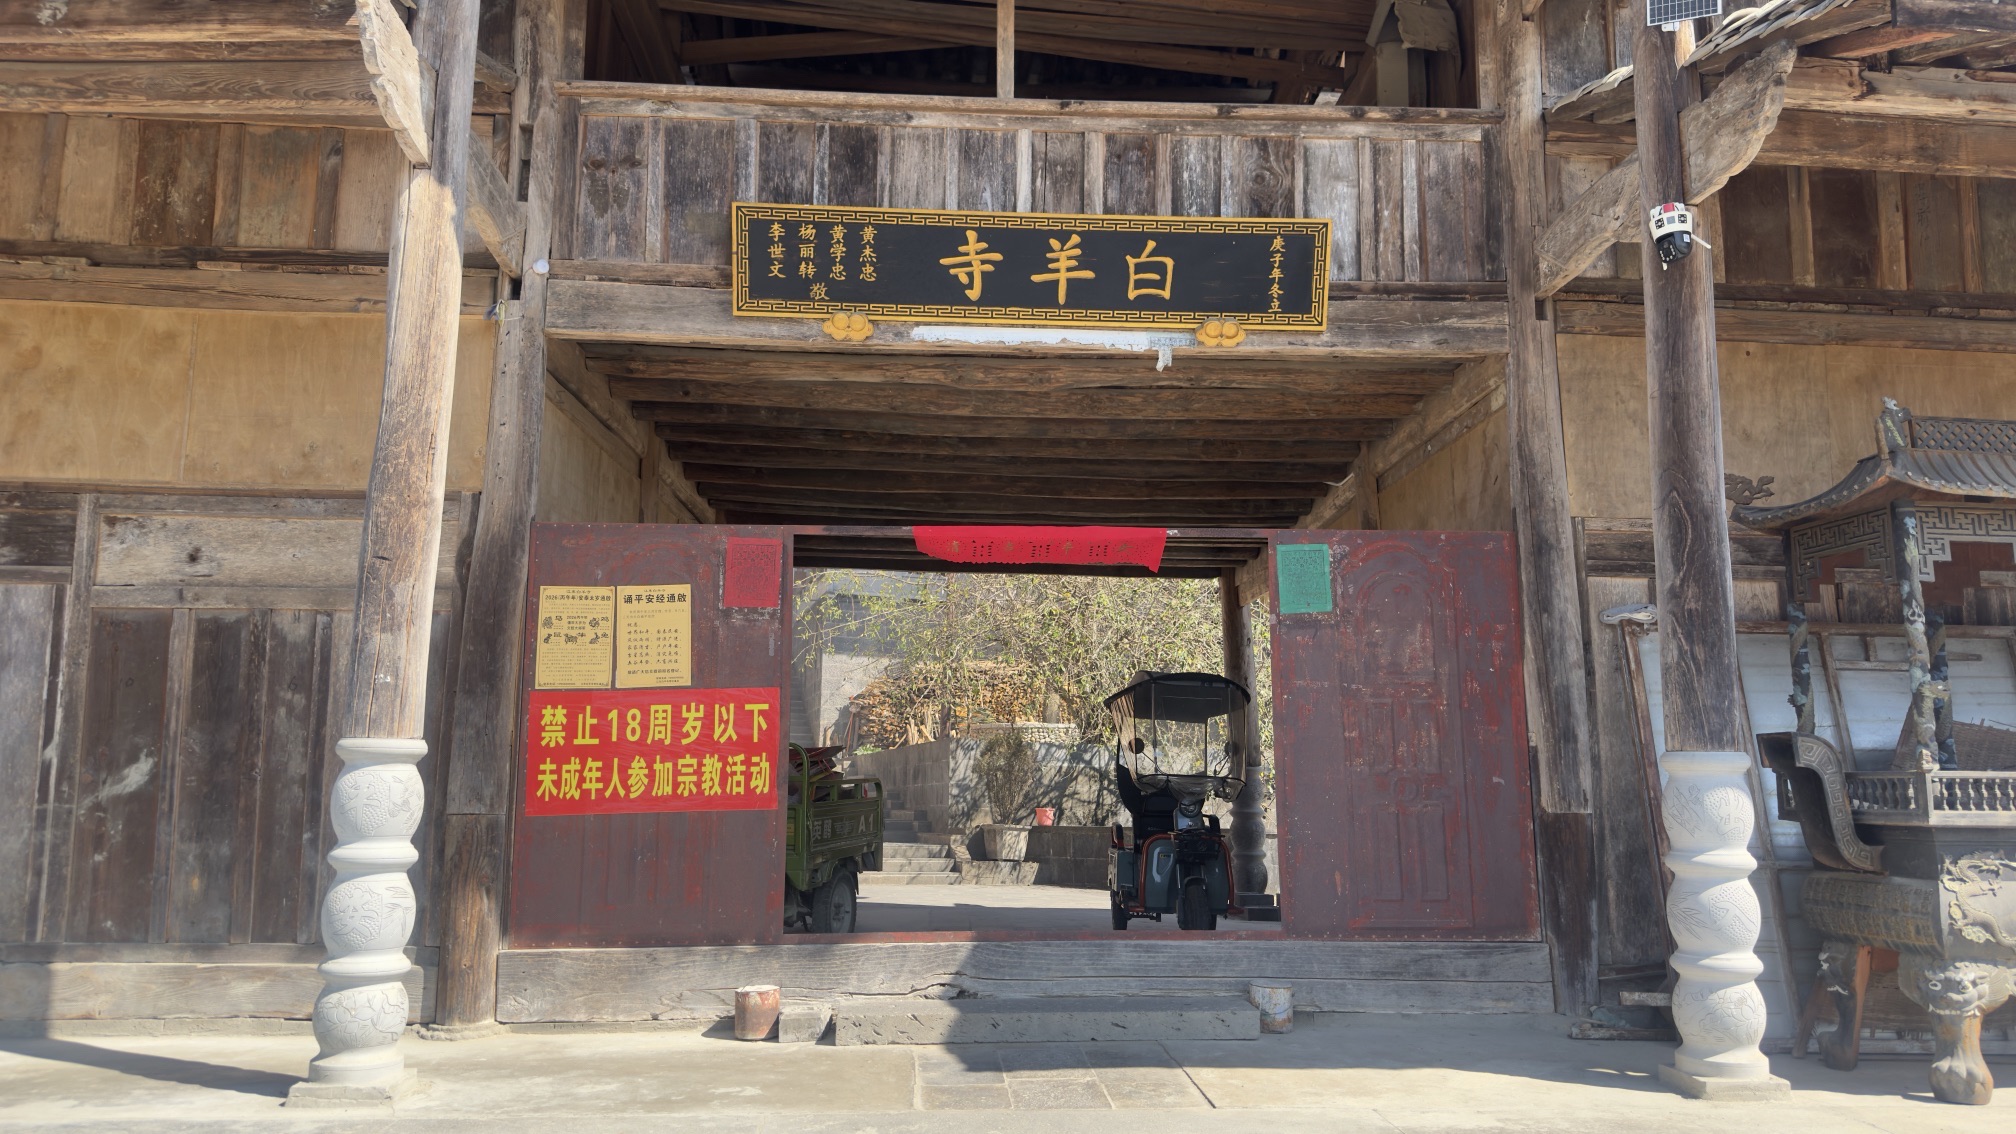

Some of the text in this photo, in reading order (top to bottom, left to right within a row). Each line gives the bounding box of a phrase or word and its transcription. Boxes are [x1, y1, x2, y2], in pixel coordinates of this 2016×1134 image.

[767, 221, 786, 278] 李世文
[798, 223, 817, 279] 杨丽转
[829, 224, 847, 280] 黄学忠
[859, 225, 878, 281] 黄杰忠
[939, 229, 1175, 305] 白羊寺
[1267, 235, 1286, 312] 庚子年冬立
[809, 282, 830, 300] 敬
[540, 702, 770, 748] 禁止18周岁以下
[536, 752, 770, 801] 未成年人参加宗教活动
